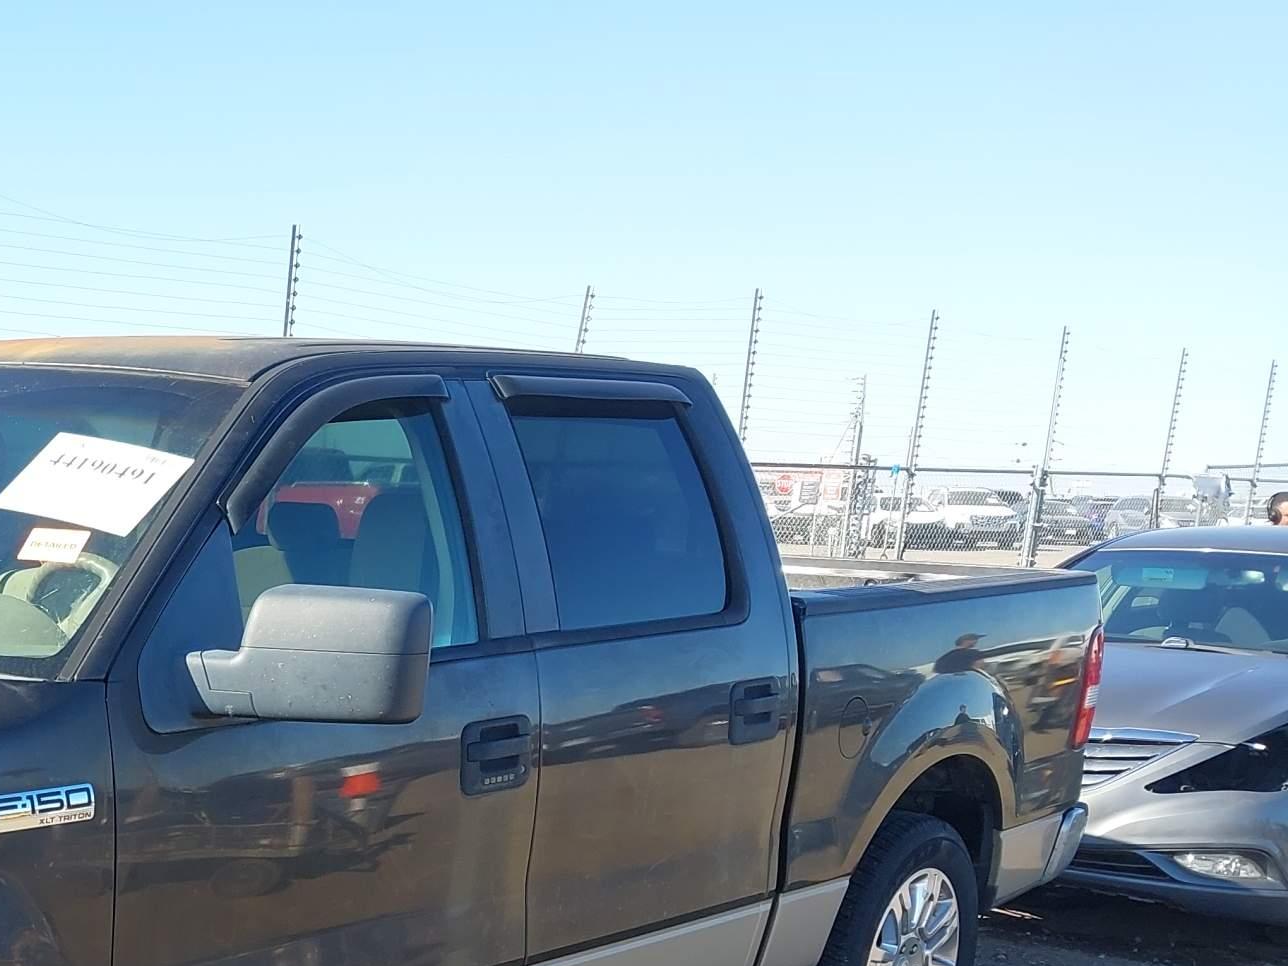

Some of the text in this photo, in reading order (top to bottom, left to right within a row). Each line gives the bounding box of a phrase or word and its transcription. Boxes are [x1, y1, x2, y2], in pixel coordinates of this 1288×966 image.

[49, 453, 157, 485] 44190491
[39, 811, 92, 825] XLT TRITON
